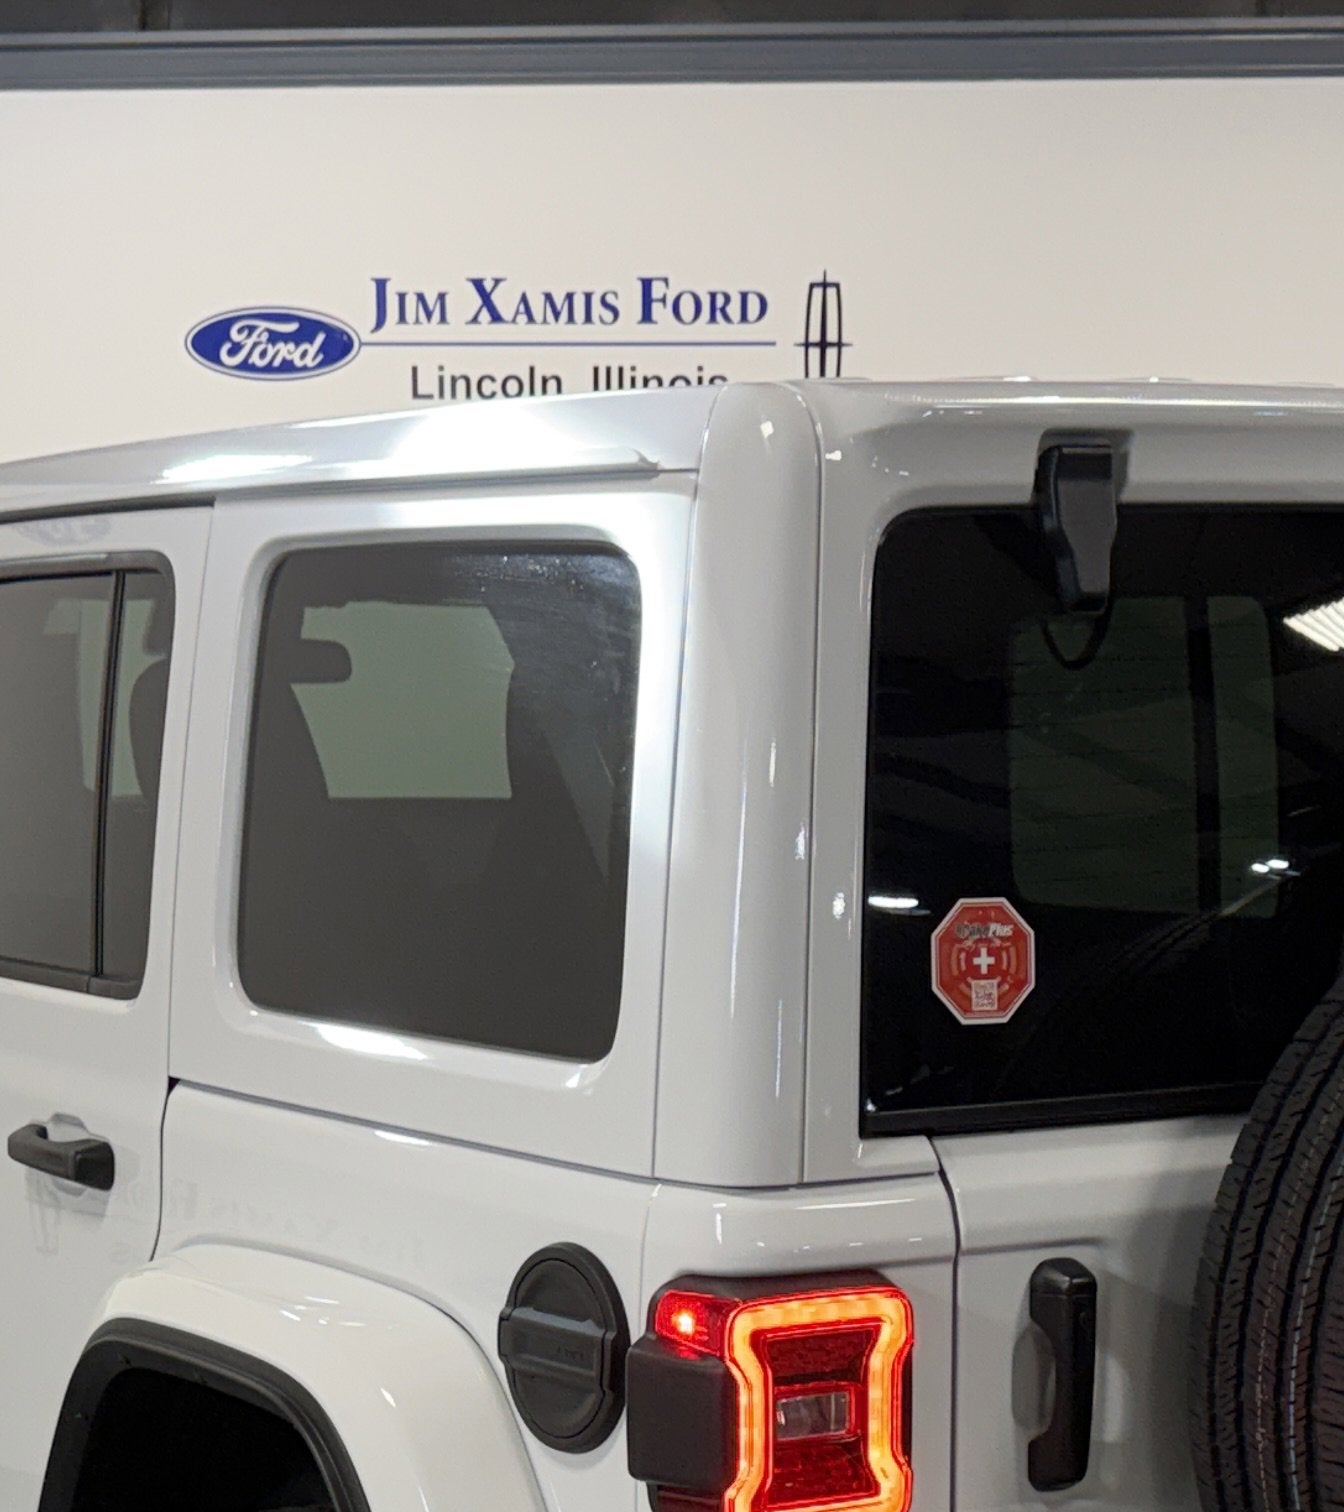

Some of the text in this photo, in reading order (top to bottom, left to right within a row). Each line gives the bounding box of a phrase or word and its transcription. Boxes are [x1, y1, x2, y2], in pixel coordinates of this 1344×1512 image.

[466, 277, 620, 325] XAMIS
[637, 277, 767, 325] FORD
[219, 320, 325, 368] Ford
